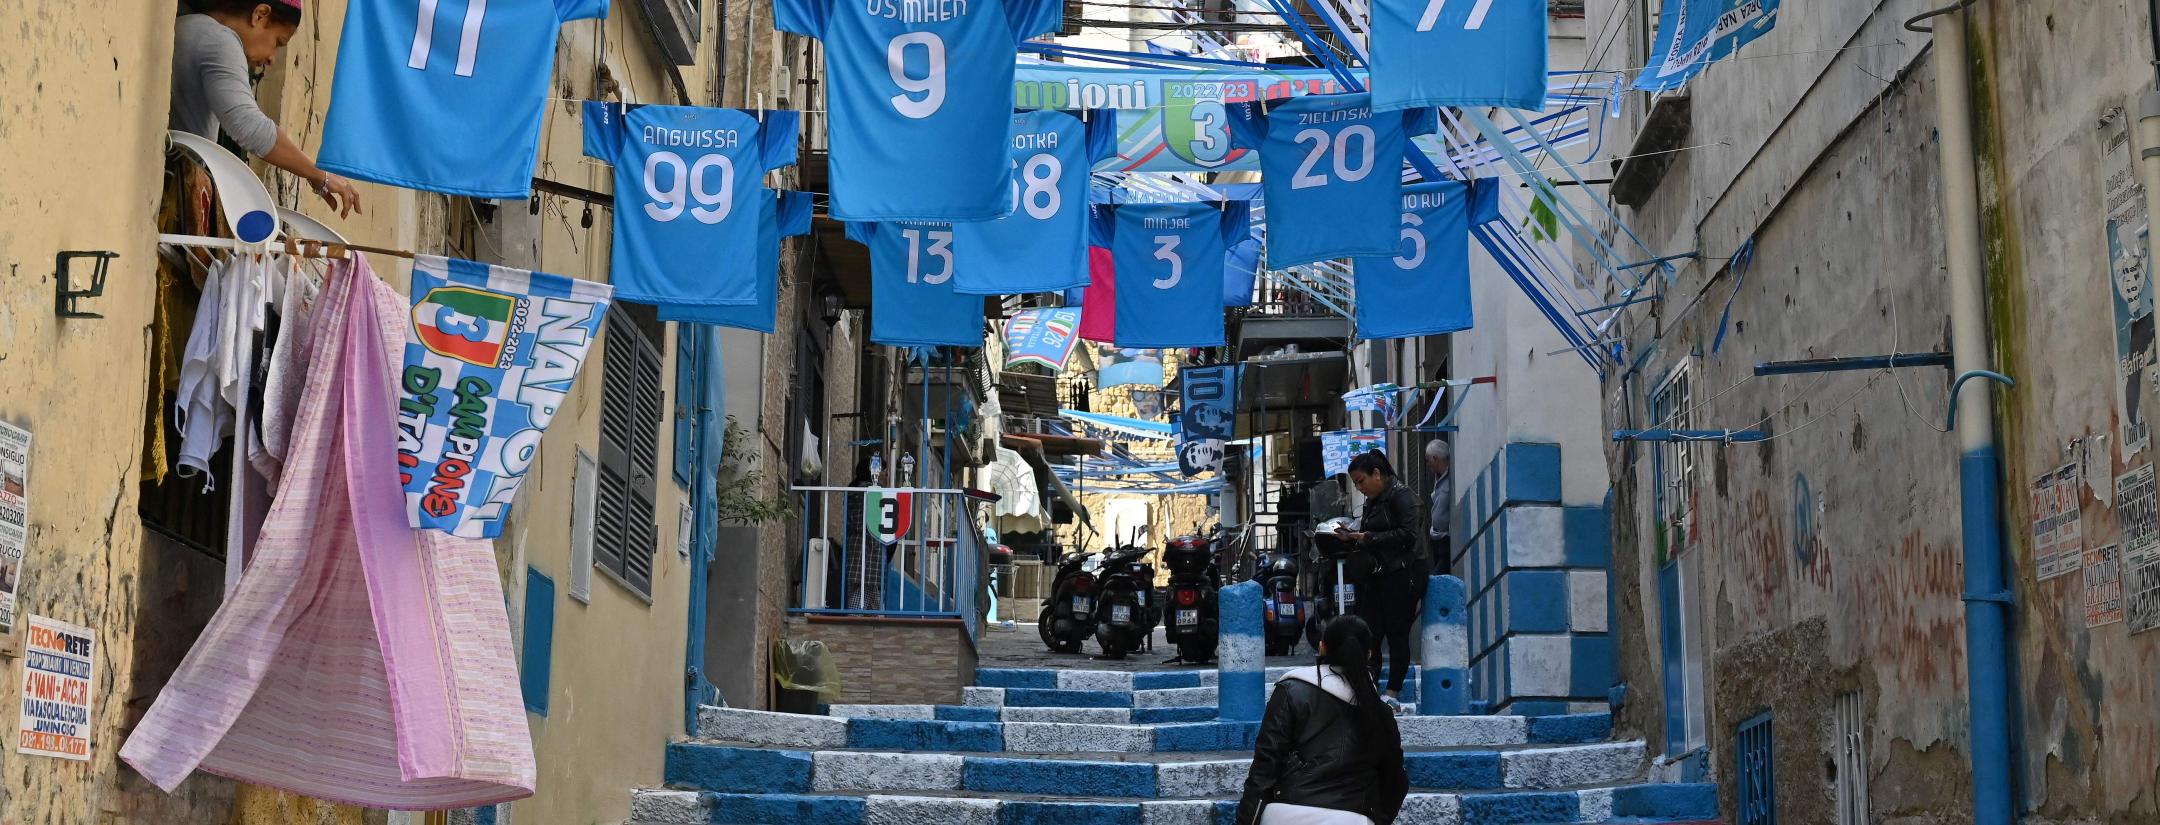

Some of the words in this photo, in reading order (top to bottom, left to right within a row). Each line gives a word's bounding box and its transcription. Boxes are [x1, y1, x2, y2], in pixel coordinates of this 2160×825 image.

[888, 32, 946, 118] 9
[1171, 83, 1249, 98] 2022/23
[643, 125, 738, 148] ANGUISSA
[1012, 132, 1058, 150] OTKA
[1190, 101, 1229, 161] 3
[1292, 125, 1376, 190] 20
[644, 151, 734, 224] 99
[1421, 192, 1446, 209] RUI
[1144, 217, 1190, 229] MINJAE
[1393, 212, 1426, 270] 6
[903, 228, 953, 285] 13
[1152, 235, 1182, 290] 3
[435, 306, 490, 342] 3
[499, 298, 531, 370] 2022-2023
[1187, 366, 1226, 401] 10
[469, 297, 597, 521] NAPOLI
[421, 375, 493, 518] CAMPIONE
[878, 498, 899, 534] 3
[2083, 545, 2118, 567] TECNORETE
[31, 625, 90, 657] TECNORETE
[26, 671, 33, 697] 4
[33, 720, 76, 736] LUMINOSO
